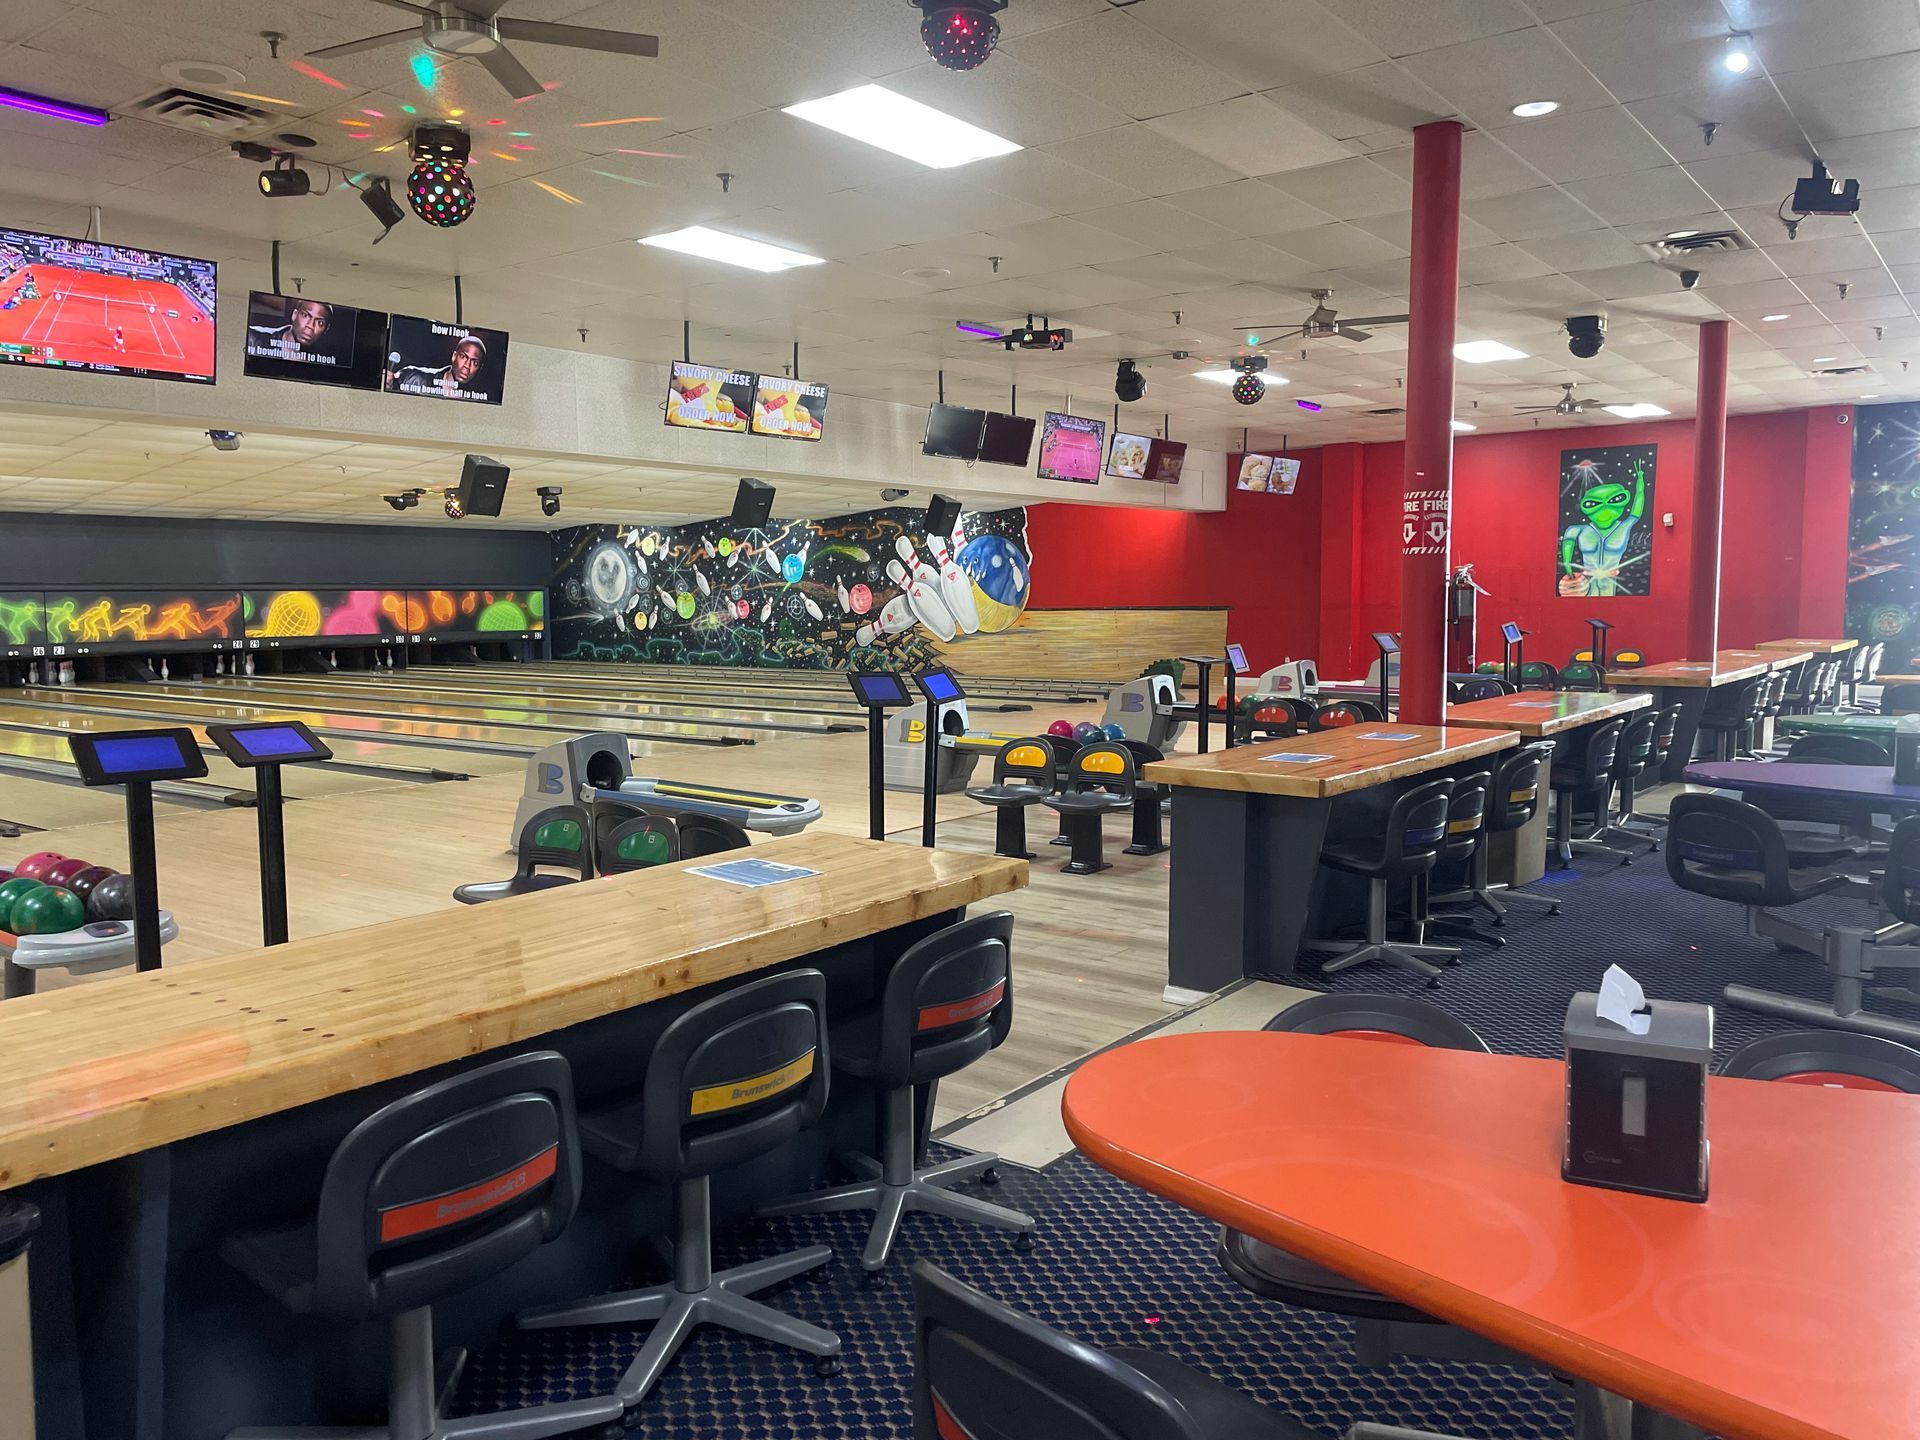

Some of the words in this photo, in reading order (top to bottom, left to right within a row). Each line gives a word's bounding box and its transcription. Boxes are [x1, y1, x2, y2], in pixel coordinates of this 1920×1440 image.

[432, 324, 448, 334] how
[453, 327, 469, 337] look
[270, 338, 301, 351] waiting
[257, 345, 288, 359] bowling
[291, 350, 306, 360] ball
[308, 352, 316, 362] to
[317, 354, 336, 365] hook
[674, 365, 713, 380] SAVORY
[716, 371, 751, 386] CHEESE
[433, 378, 459, 389] waiting
[758, 377, 793, 392] SAVORY
[794, 383, 826, 398] CHEESE
[400, 383, 410, 392] on
[410, 384, 421, 393] my
[422, 385, 449, 396] bowling
[450, 389, 463, 397] ball
[464, 390, 471, 398] to
[471, 391, 488, 400] hook
[678, 406, 711, 421] ORDER
[760, 416, 789, 431] ORDER
[1423, 500, 1449, 511] FIRE
[731, 1076, 786, 1100] Brunswick
